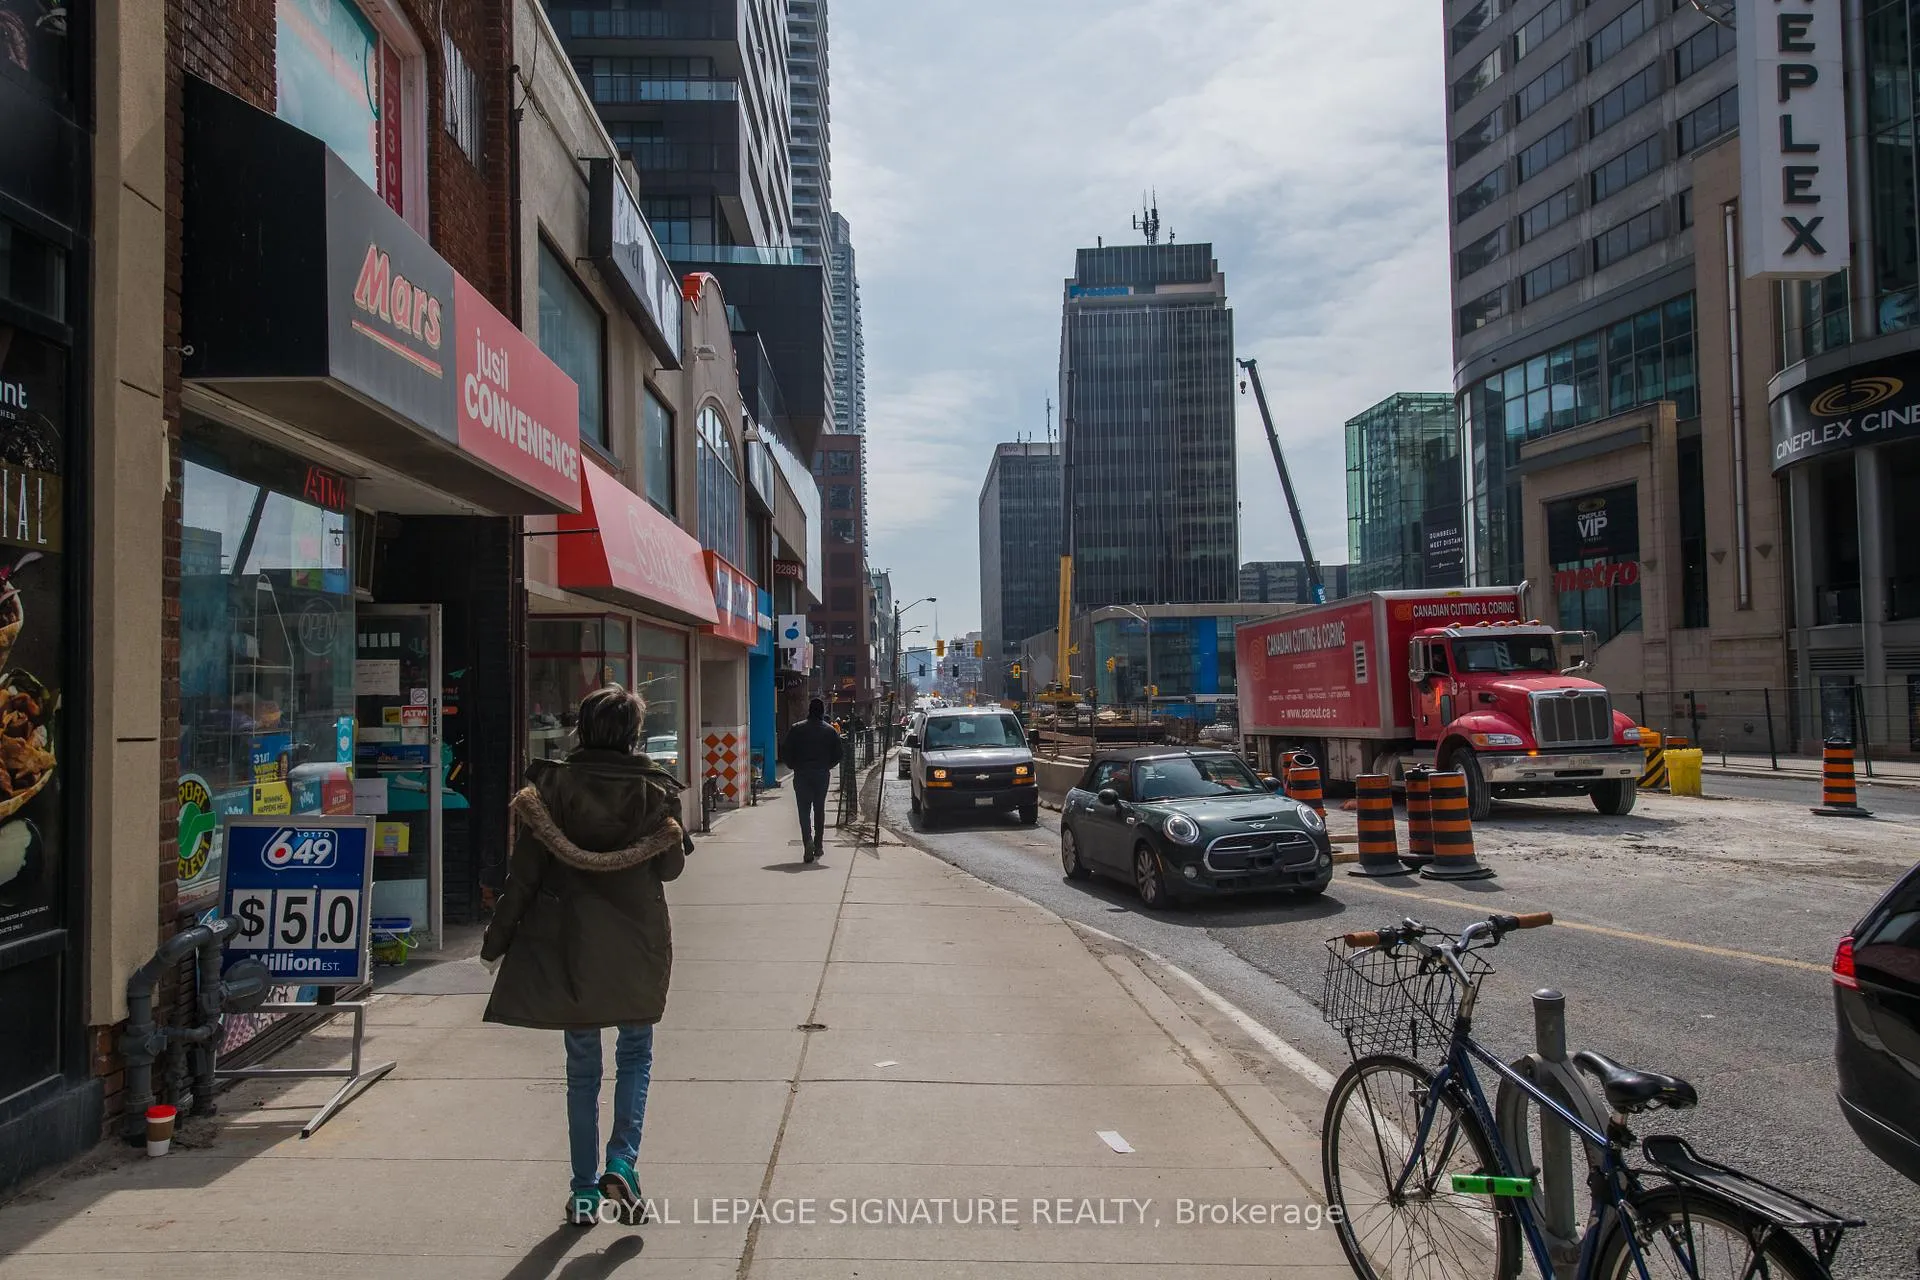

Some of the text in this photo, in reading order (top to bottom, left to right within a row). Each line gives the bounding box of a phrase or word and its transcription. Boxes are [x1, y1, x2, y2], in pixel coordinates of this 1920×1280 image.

[1777, 0, 1827, 255] EPLEX
[353, 243, 443, 350] Mars
[476, 327, 509, 393] jusil
[465, 373, 578, 483] CONVENIENCE
[1776, 418, 1853, 460] CINEPLEX
[303, 464, 346, 512] ATM
[1577, 510, 1607, 521] CINEPLEX
[1577, 516, 1608, 538] VIP
[775, 563, 797, 575] 2289
[1554, 560, 1639, 595] metro
[1413, 601, 1515, 617] CANADIAN CUTTING & CORING
[302, 612, 339, 642] OPEN
[1267, 620, 1346, 656] CANADIAN CUTTING & CORING
[403, 709, 427, 718] ATM
[1286, 706, 1331, 719] www.cancut.ca
[321, 962, 340, 971] EST.
